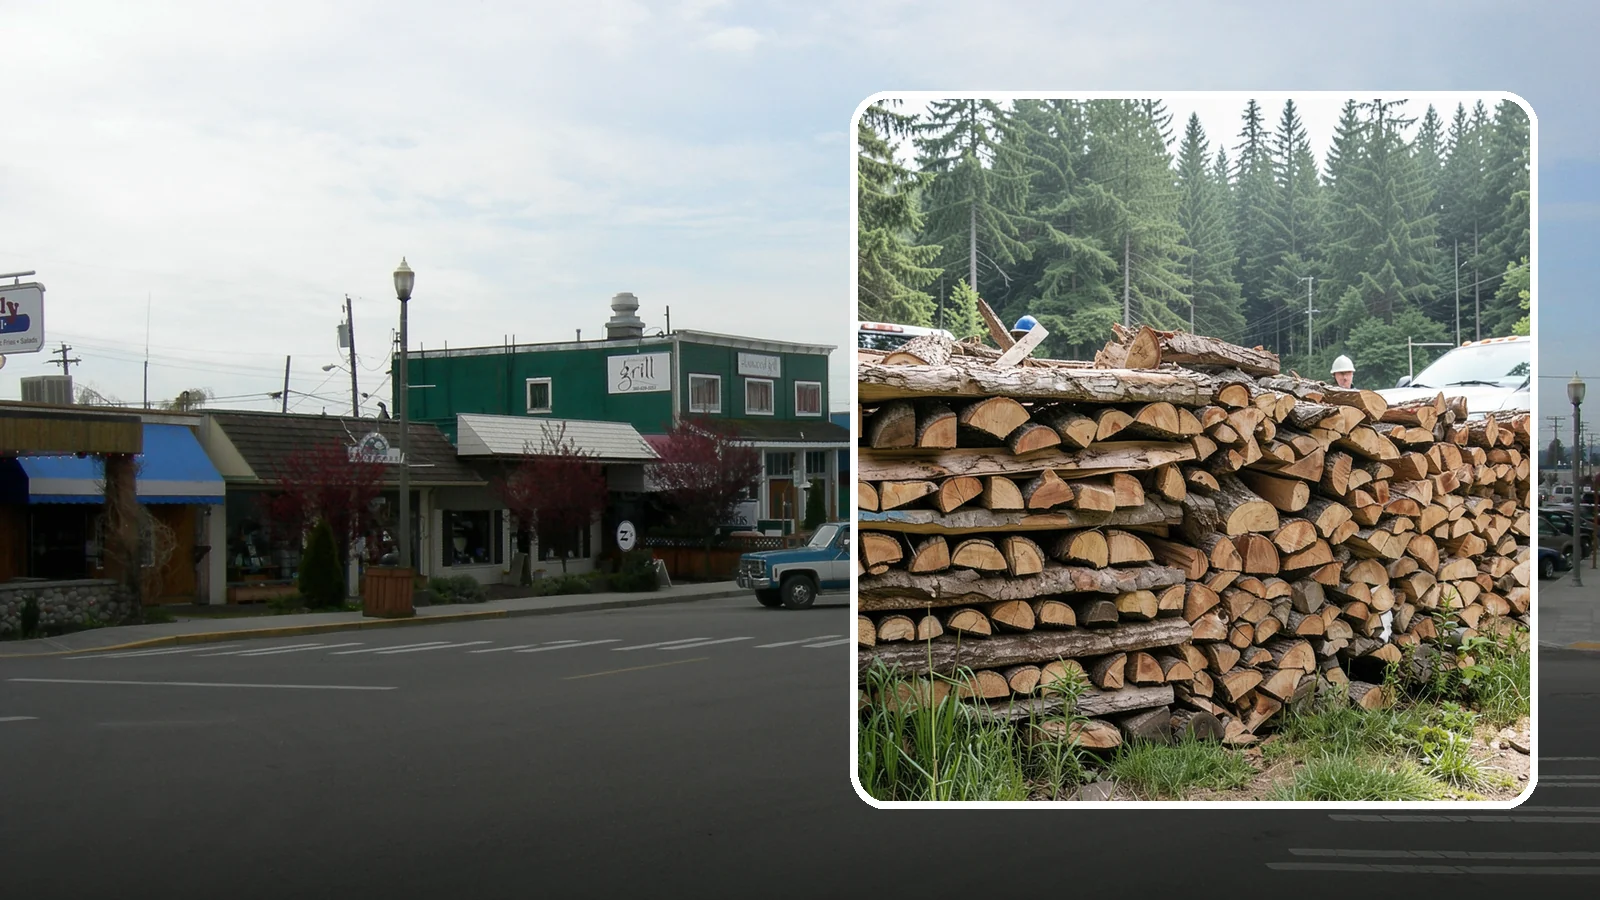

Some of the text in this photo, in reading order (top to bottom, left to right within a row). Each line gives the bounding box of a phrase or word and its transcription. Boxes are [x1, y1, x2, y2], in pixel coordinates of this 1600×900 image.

[20, 337, 38, 345] Salads
[618, 356, 655, 391] grill
[619, 530, 634, 541] Z's
